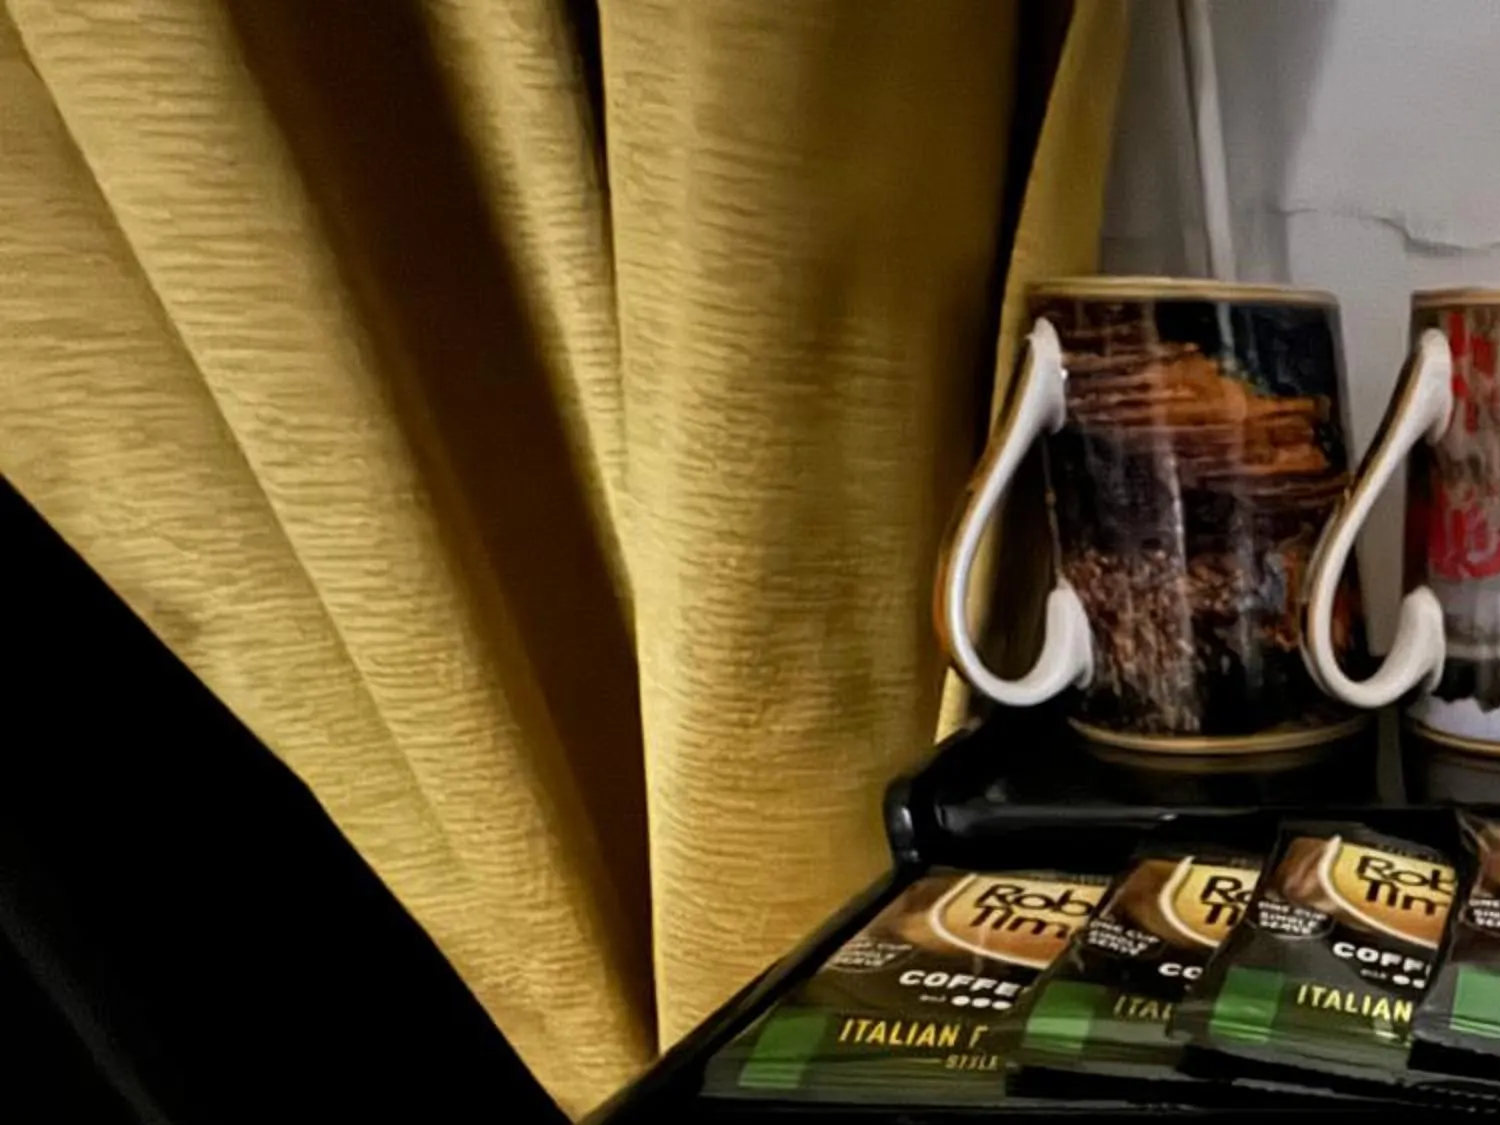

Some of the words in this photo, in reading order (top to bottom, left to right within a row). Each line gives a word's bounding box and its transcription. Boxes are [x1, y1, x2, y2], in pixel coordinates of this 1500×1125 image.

[975, 884, 1094, 917] Rob
[1333, 941, 1432, 977] COFF
[899, 969, 1032, 997] COFFE
[1297, 984, 1413, 1023] ITALIAN
[838, 1018, 960, 1048] ITALIAN
